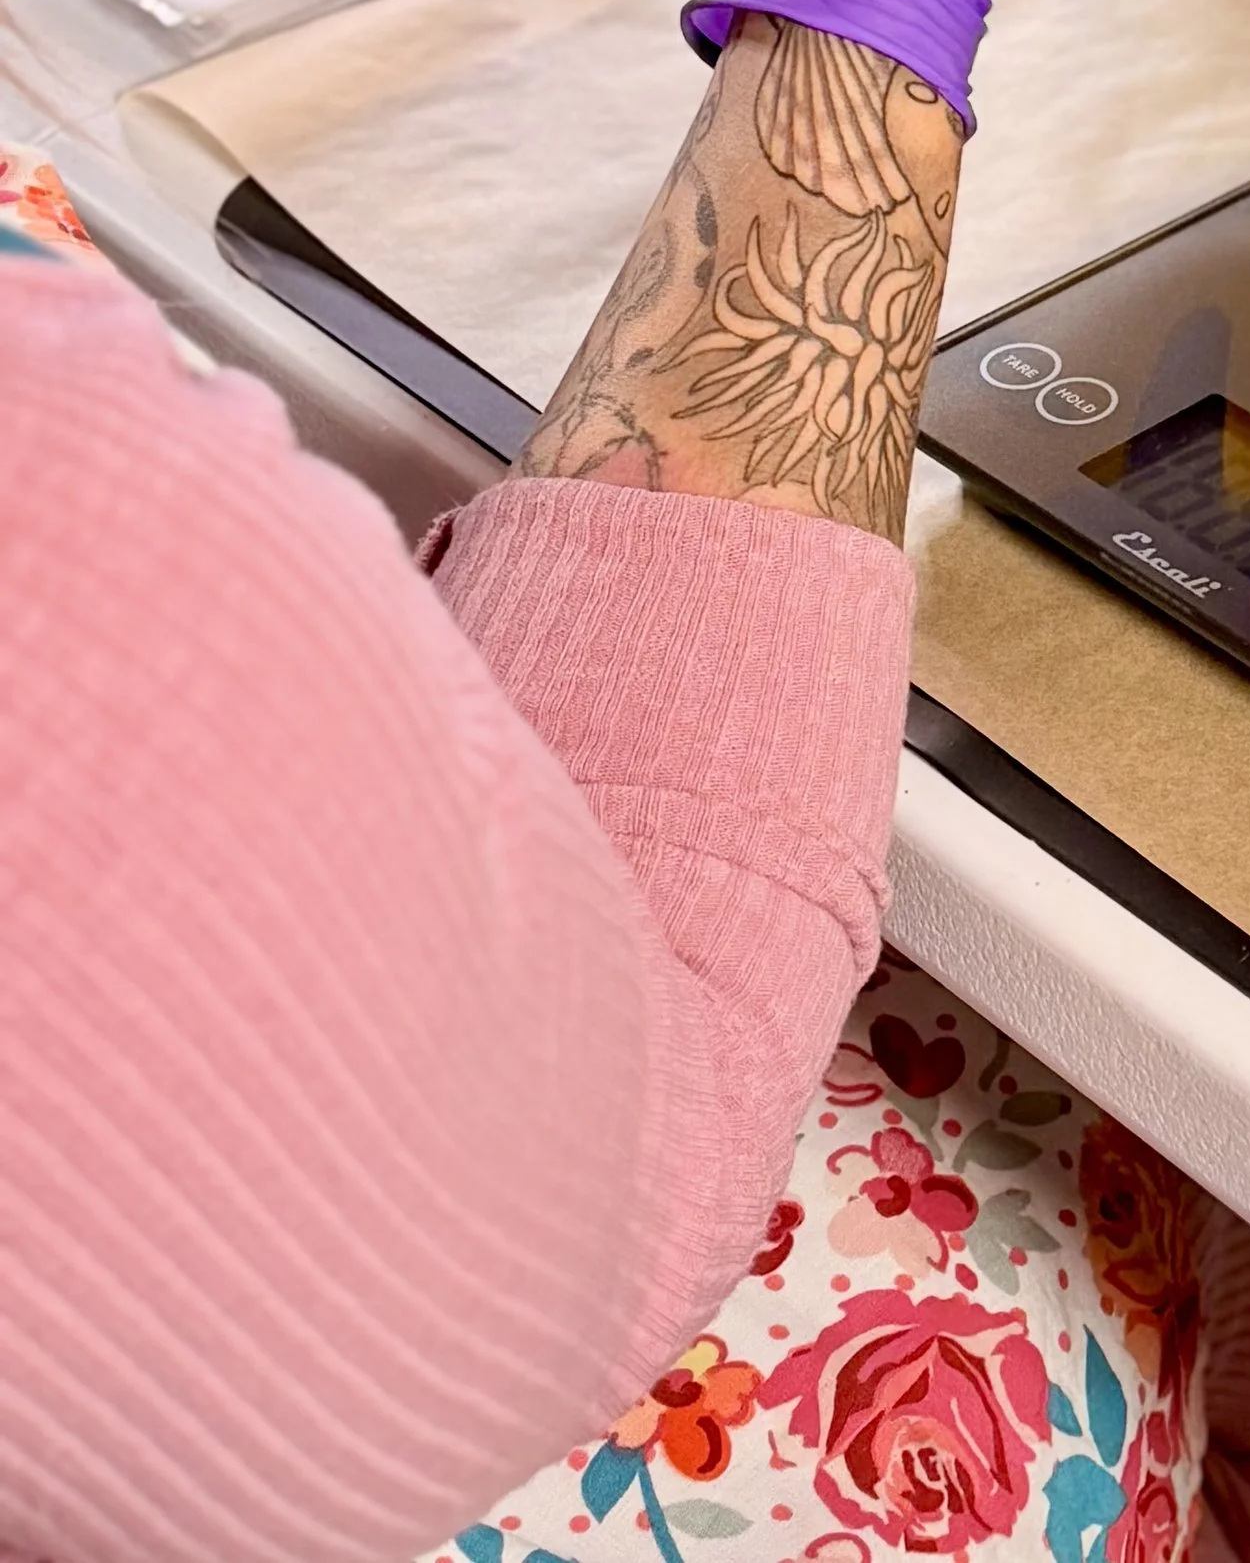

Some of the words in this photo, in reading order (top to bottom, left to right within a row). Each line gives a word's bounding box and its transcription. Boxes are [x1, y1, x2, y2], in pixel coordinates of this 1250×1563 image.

[1001, 354, 1039, 379] TARE
[1055, 388, 1096, 414] HOLD
[1112, 531, 1222, 599] Escali
